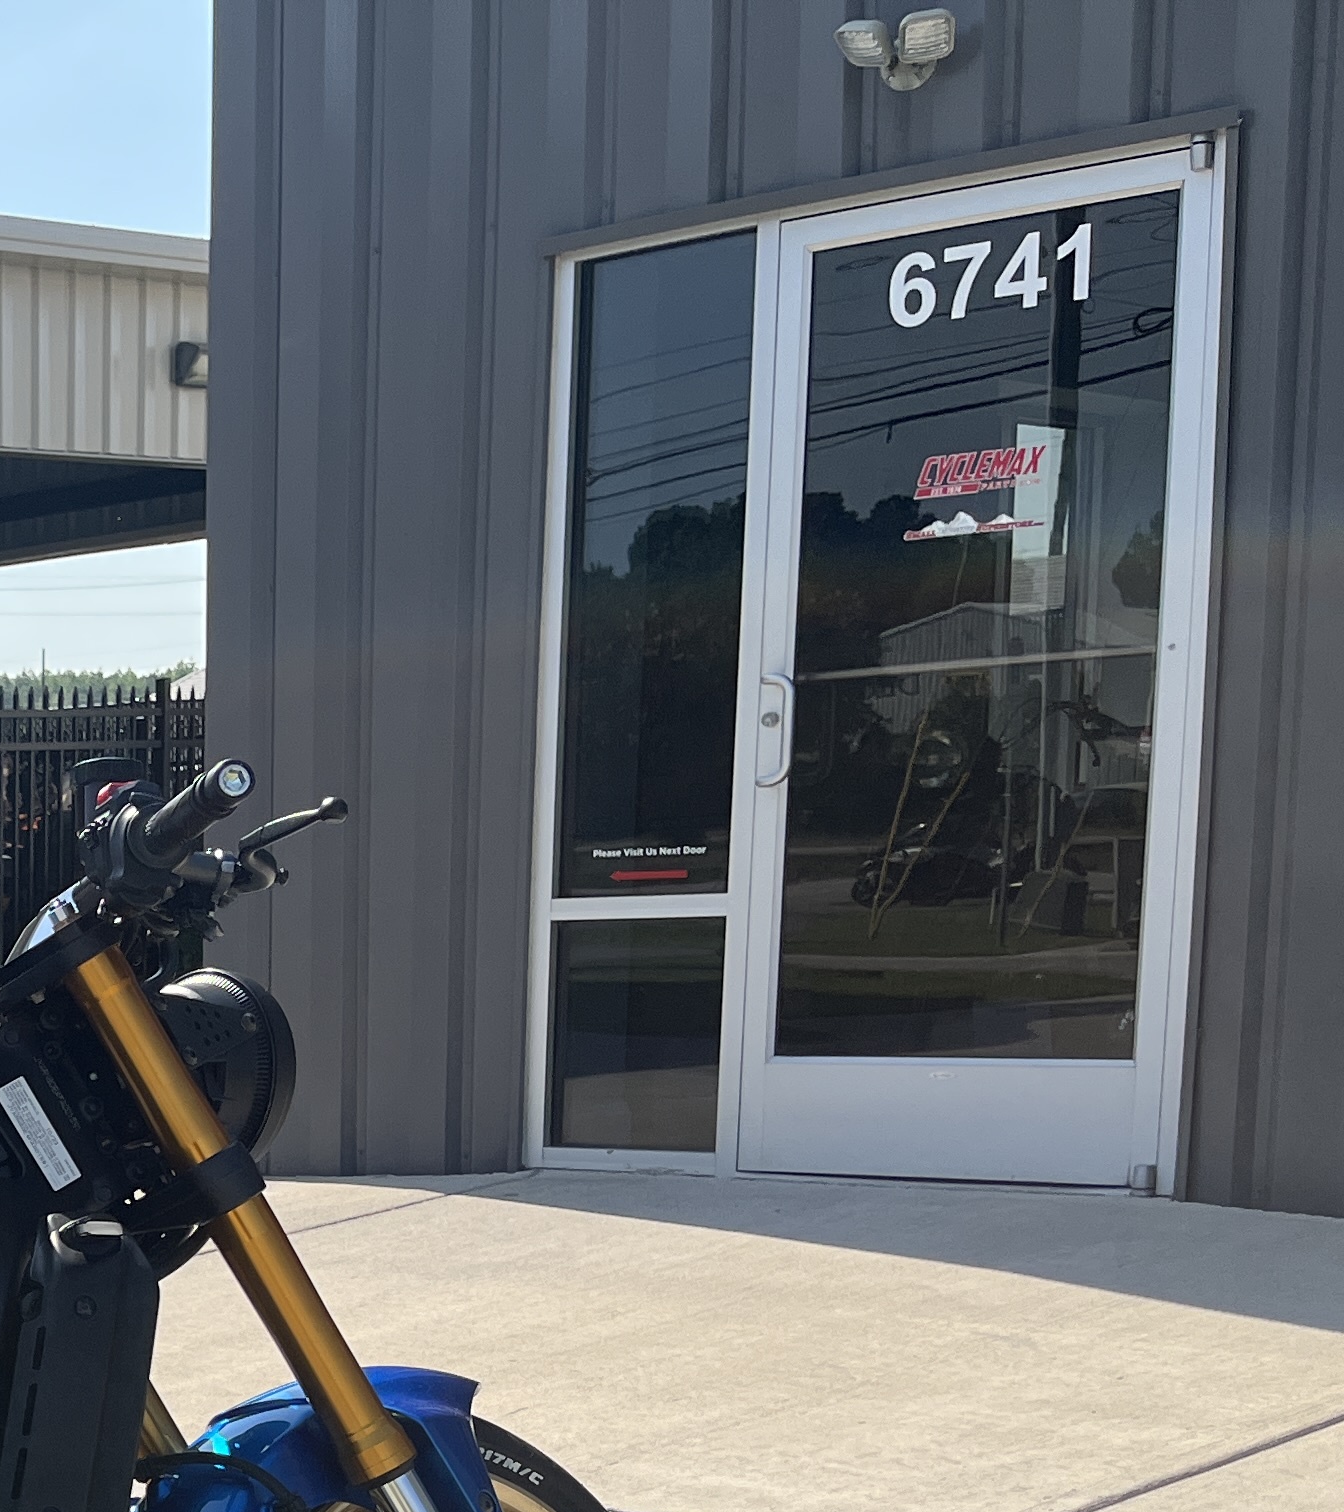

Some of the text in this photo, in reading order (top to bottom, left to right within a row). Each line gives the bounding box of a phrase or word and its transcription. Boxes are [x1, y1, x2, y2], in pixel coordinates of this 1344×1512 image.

[889, 223, 1091, 328] 6741
[917, 445, 1046, 487] CYCLEMAX
[593, 845, 707, 858] Please Visit Us Next Door
